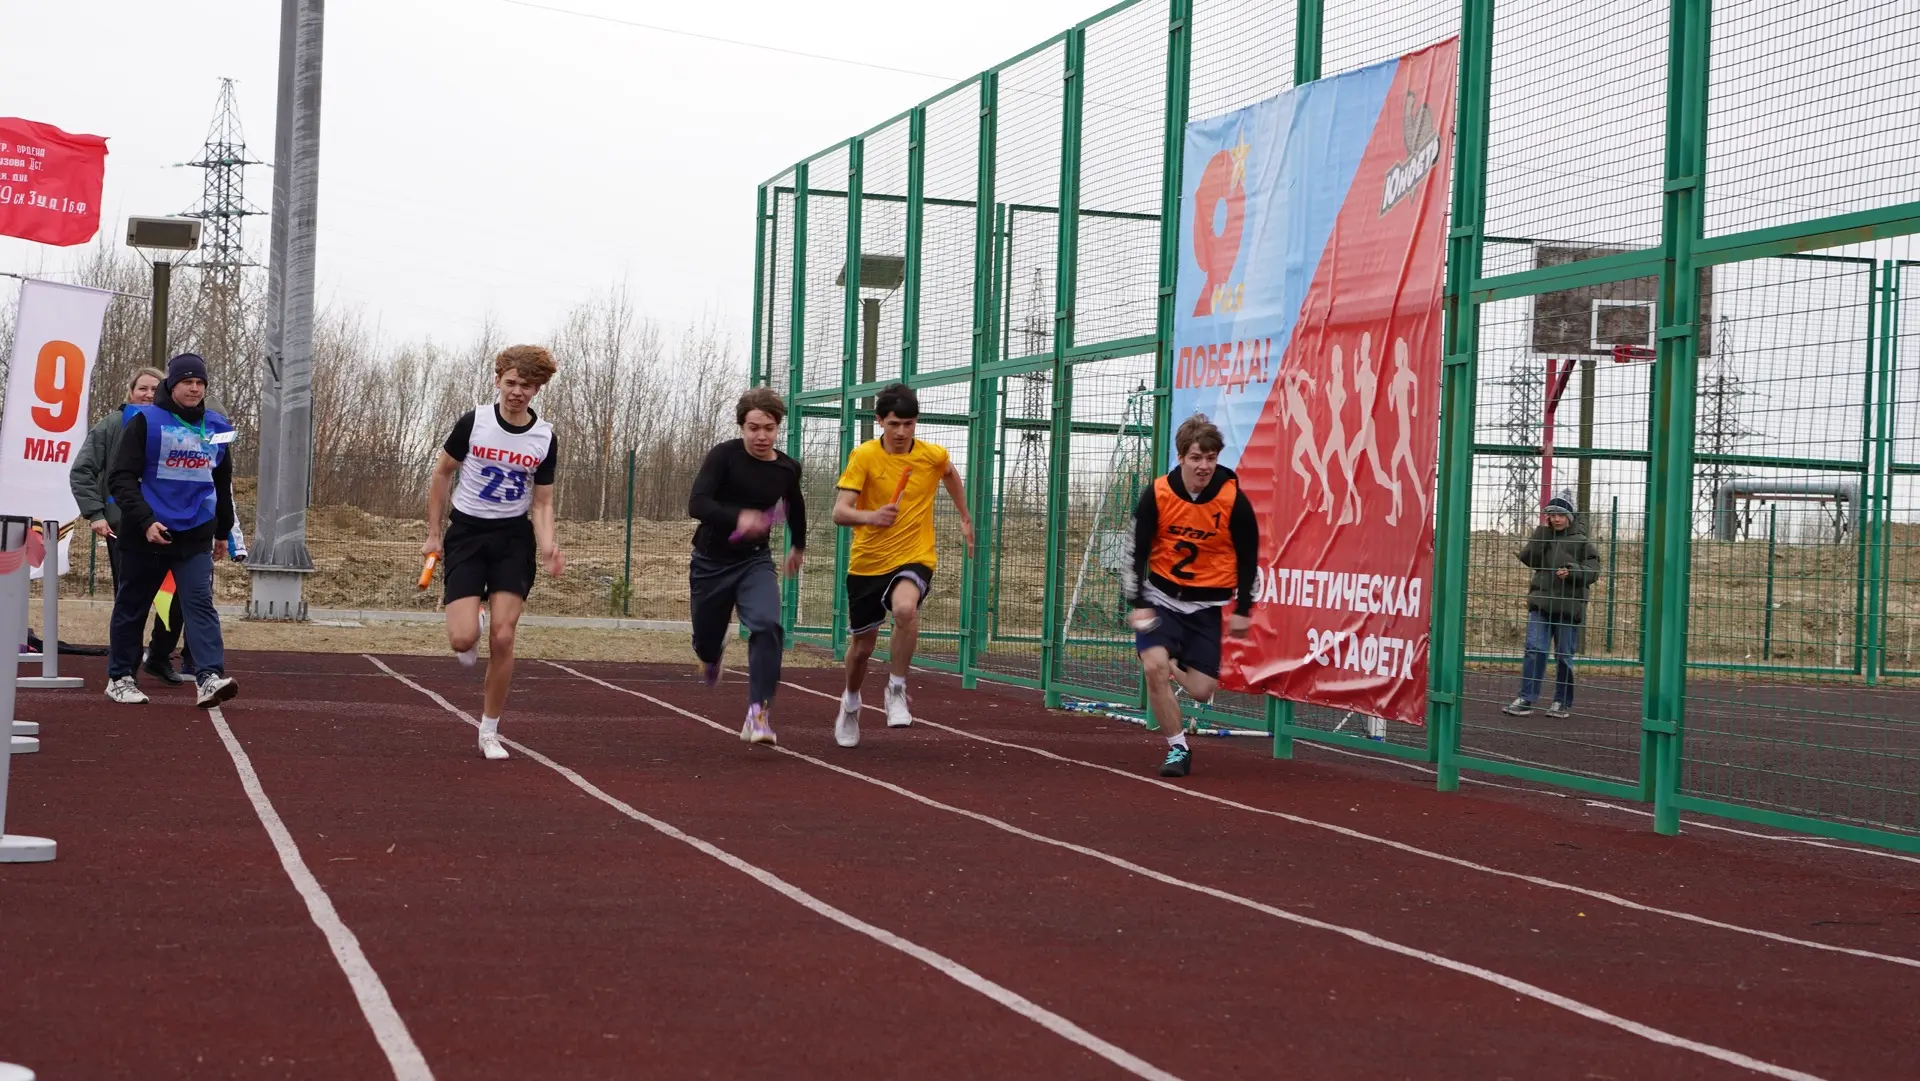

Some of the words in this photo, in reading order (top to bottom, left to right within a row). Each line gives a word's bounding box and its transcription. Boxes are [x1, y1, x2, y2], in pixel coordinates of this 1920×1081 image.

[17, 145, 45, 157] ОРДЕНА
[1175, 338, 1271, 394] ПОБЕДА!
[31, 340, 86, 433] 9
[24, 437, 71, 463] МАЯ
[479, 465, 528, 503] 23
[1168, 525, 1217, 540] star
[1213, 512, 1221, 529] 1
[1170, 540, 1199, 580] 2
[1303, 628, 1414, 680] ЭСТАФЕТА
